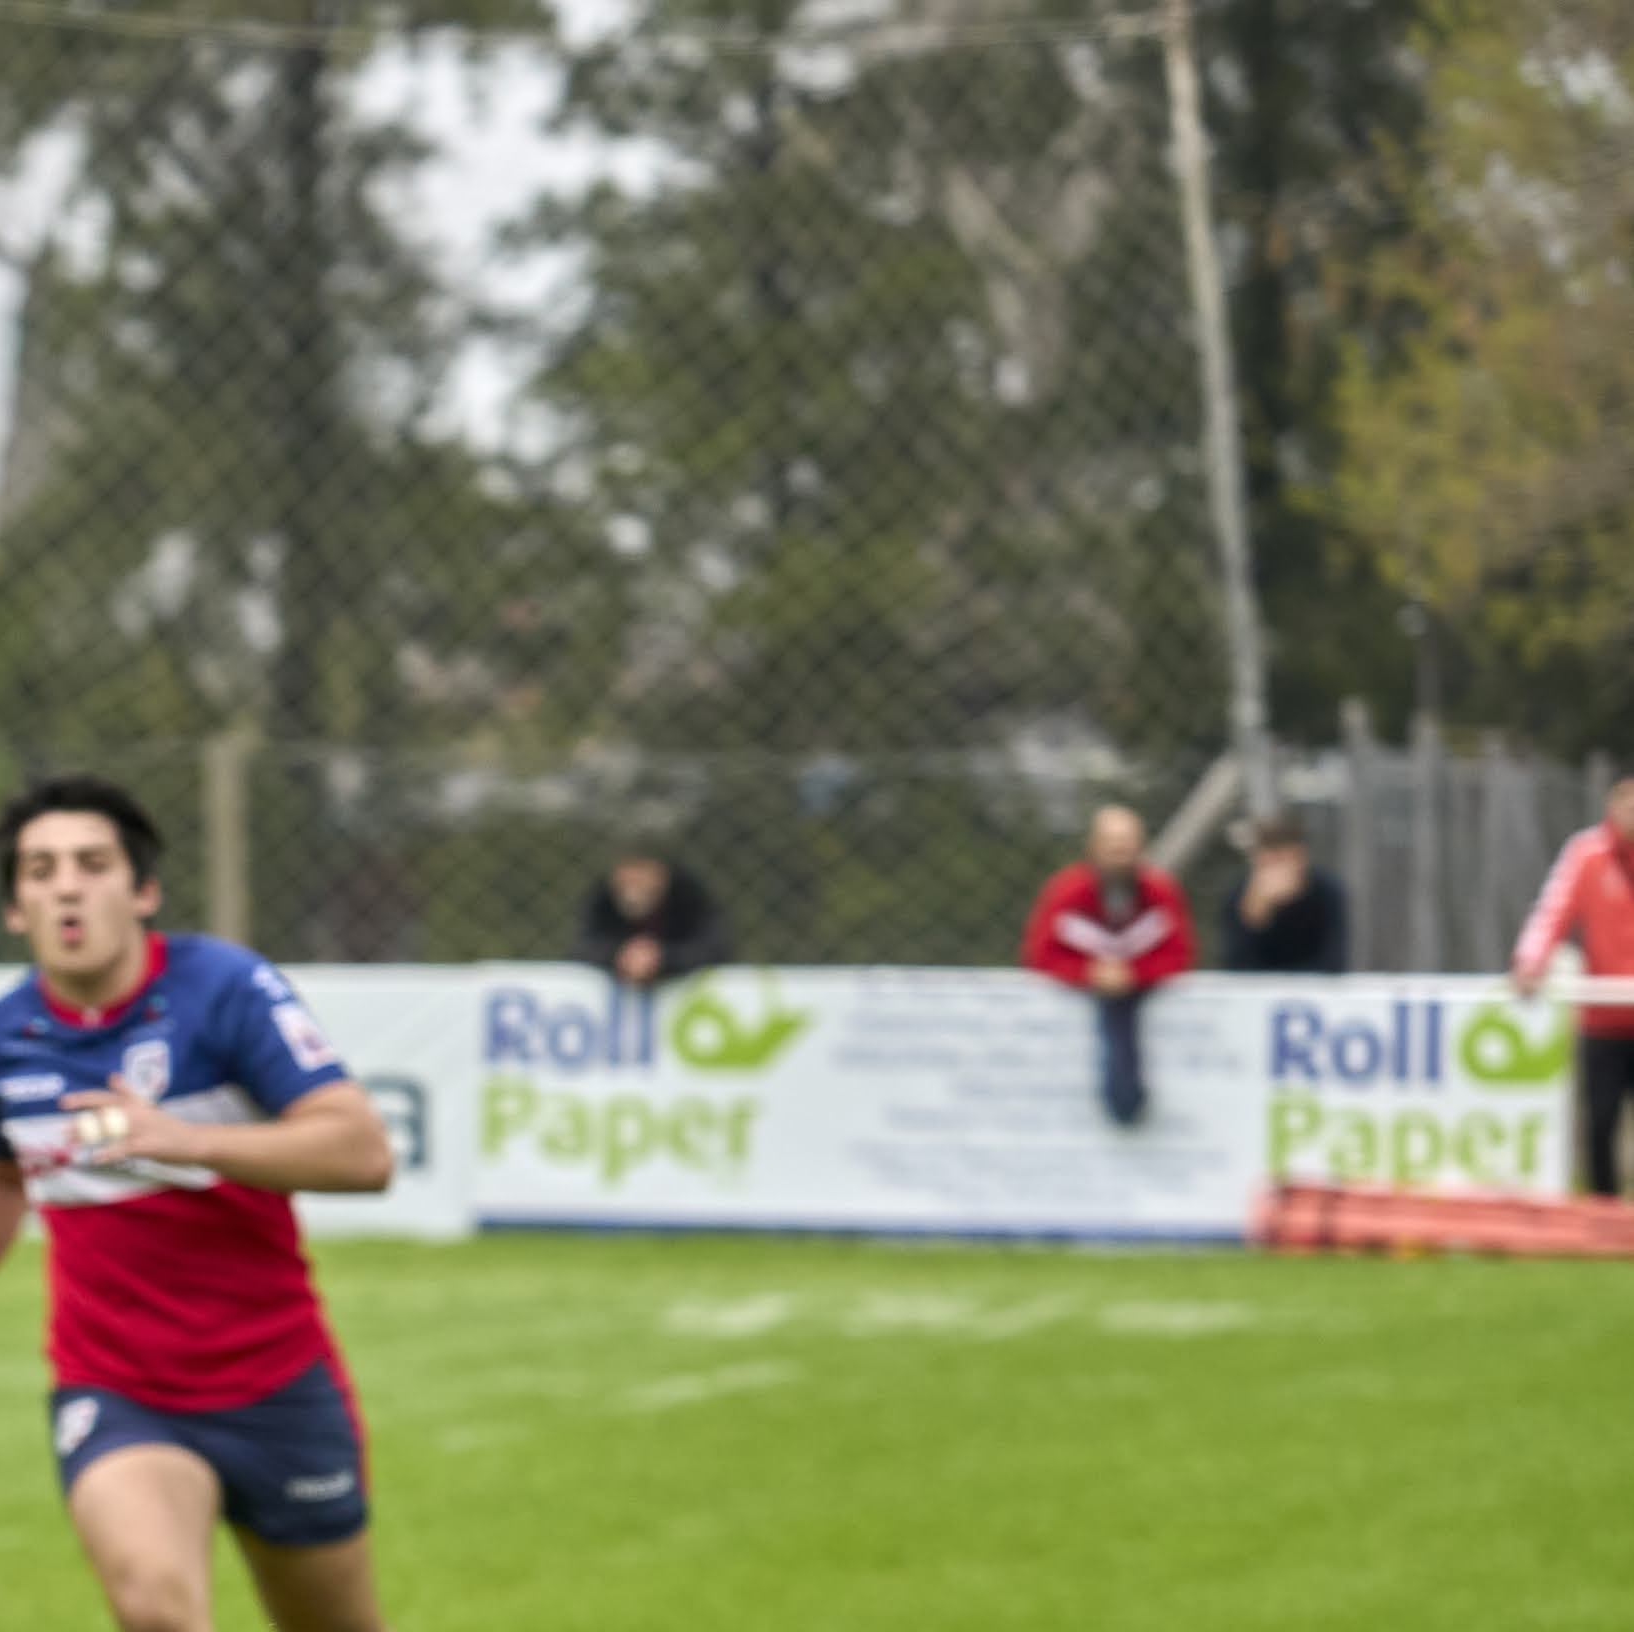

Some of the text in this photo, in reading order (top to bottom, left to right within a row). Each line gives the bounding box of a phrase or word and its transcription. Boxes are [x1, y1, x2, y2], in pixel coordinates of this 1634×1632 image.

[482, 985, 655, 1073] Roll
[1269, 1000, 1444, 1089] Roll
[481, 1074, 760, 1186] Paper
[1267, 1089, 1547, 1186] Paper
